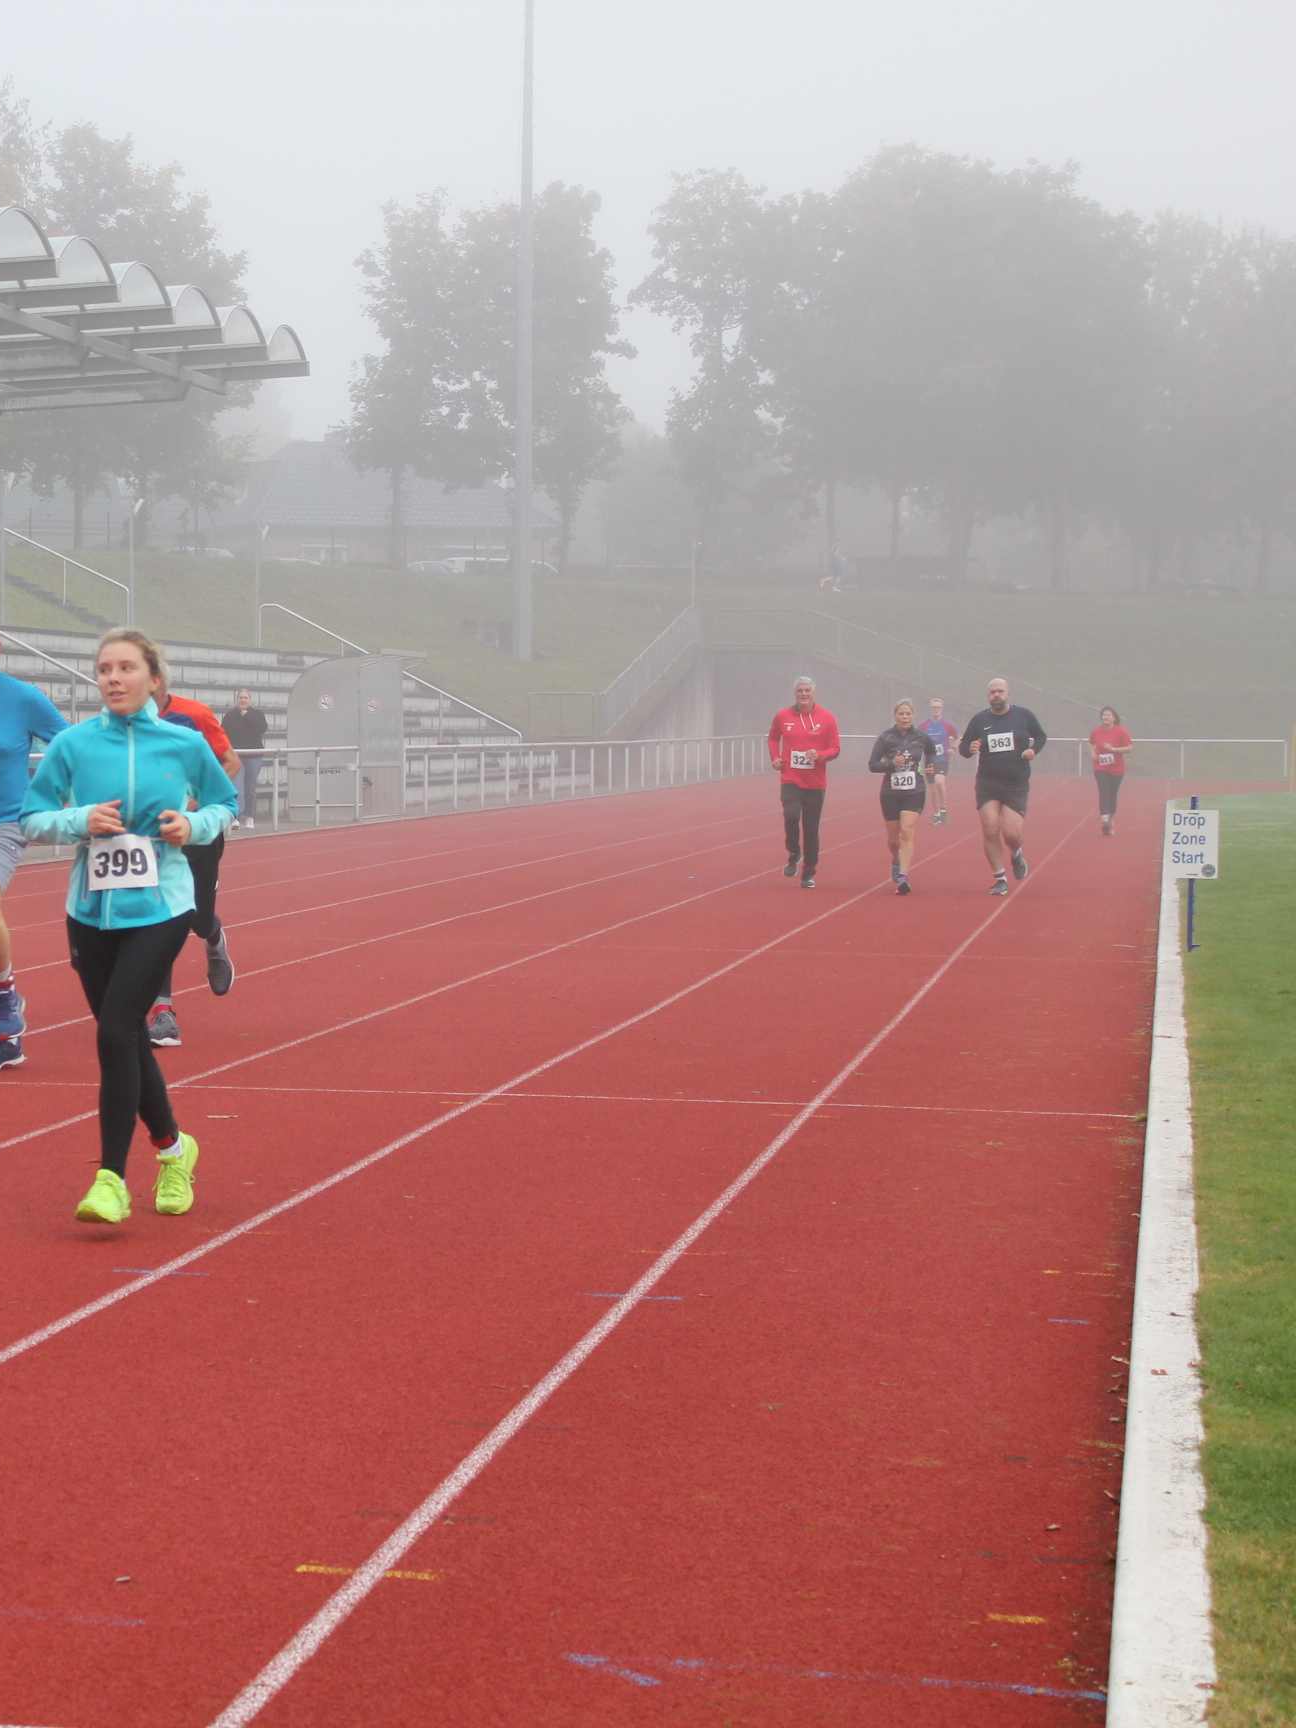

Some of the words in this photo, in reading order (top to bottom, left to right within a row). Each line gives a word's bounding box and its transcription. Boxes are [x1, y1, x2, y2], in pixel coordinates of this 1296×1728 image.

[991, 736, 1011, 749] 363
[893, 775, 913, 787] 320
[1173, 813, 1205, 829] Drop
[1172, 831, 1206, 845] Zone
[94, 848, 148, 878] 399
[1172, 850, 1204, 864] Start
